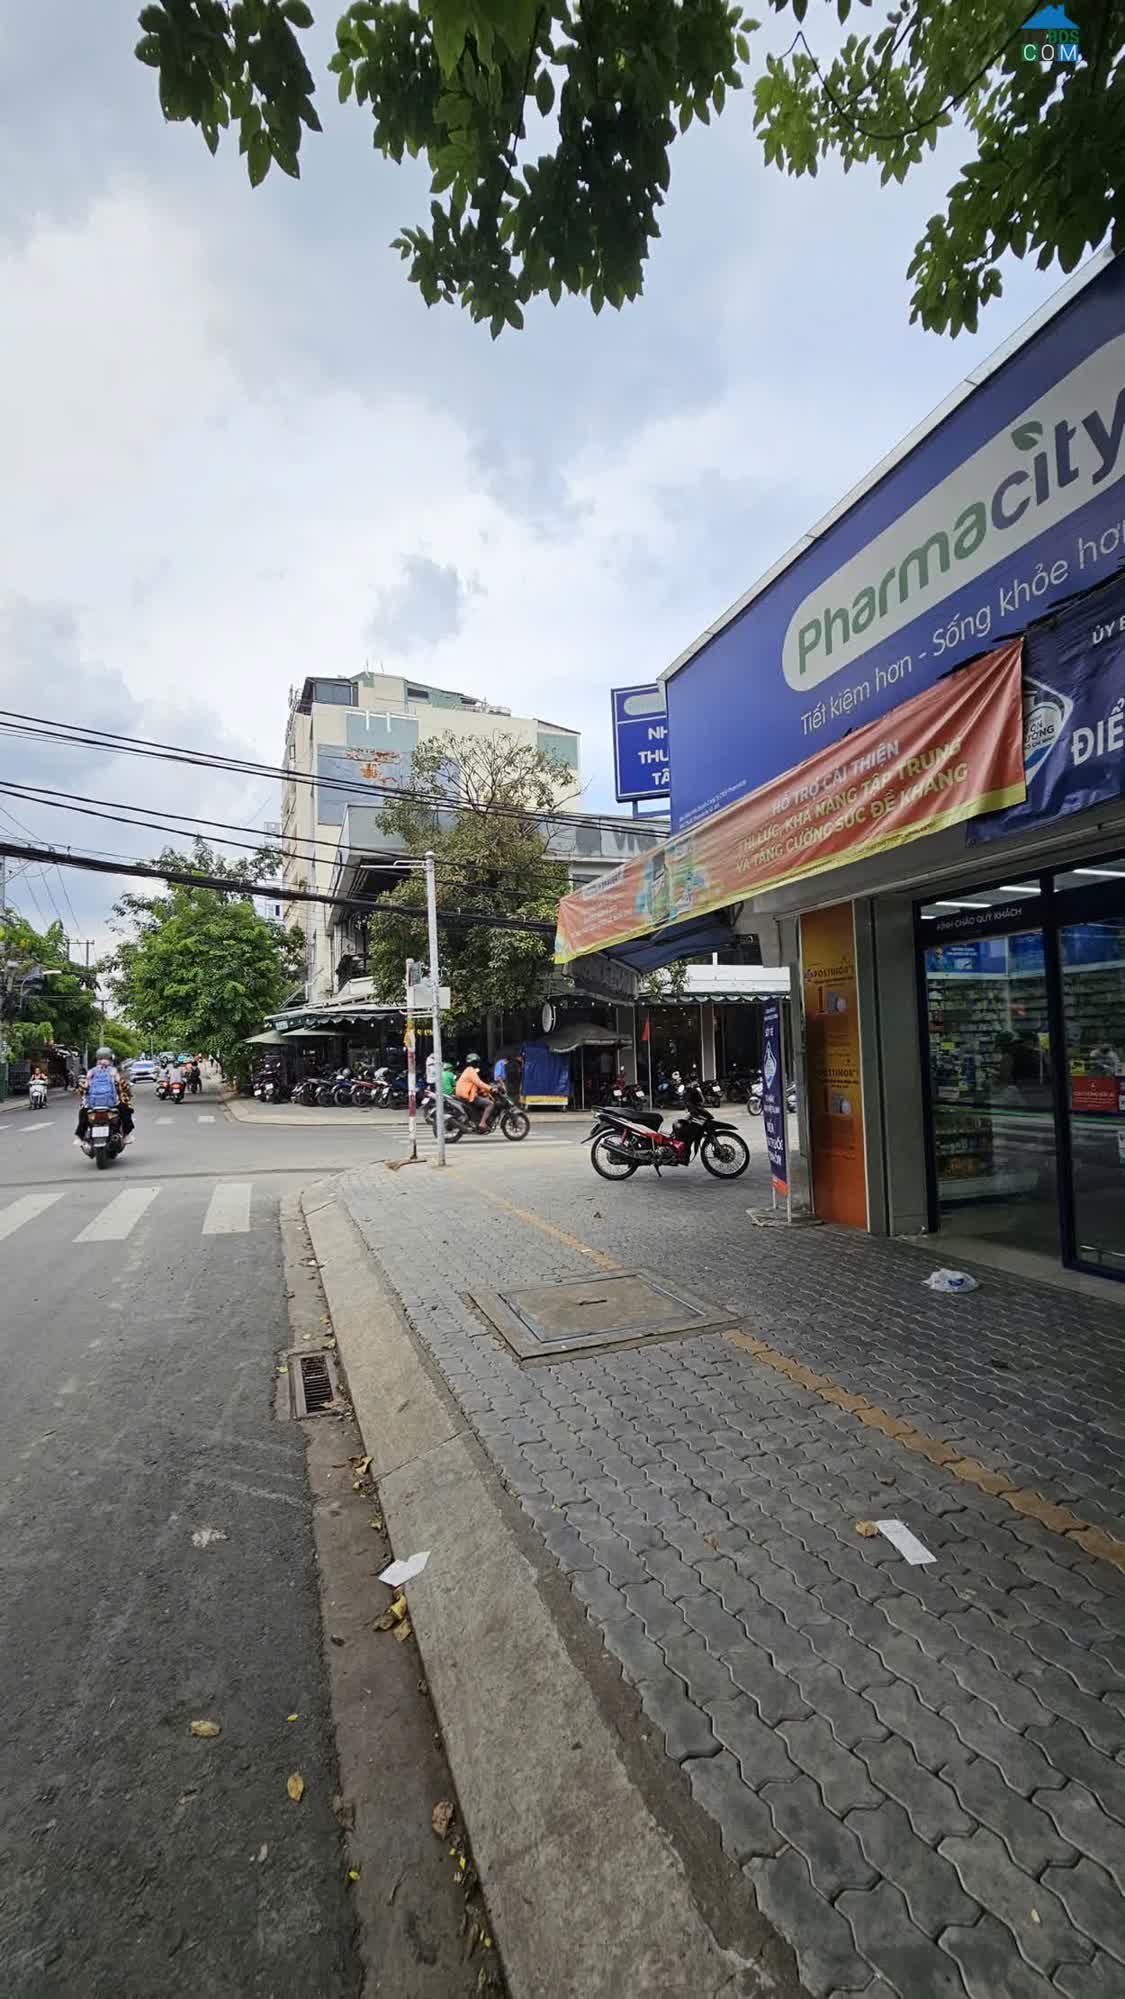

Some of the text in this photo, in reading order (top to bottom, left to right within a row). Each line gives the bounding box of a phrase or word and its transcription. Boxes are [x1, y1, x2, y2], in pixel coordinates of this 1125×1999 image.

[800, 701, 829, 736] Tiết
[830, 676, 870, 720] kiệm
[875, 653, 912, 690] hơn
[932, 603, 991, 658] Sống
[1000, 559, 1069, 618] khỏe
[1077, 521, 1125, 570] hơ
[794, 778, 820, 809] TRỢ
[851, 740, 900, 774] THIỆN
[861, 772, 893, 798] TẬP
[899, 740, 962, 781] TRUNG
[870, 789, 898, 818] ĐỀ
[900, 762, 969, 810] KHÁNG
